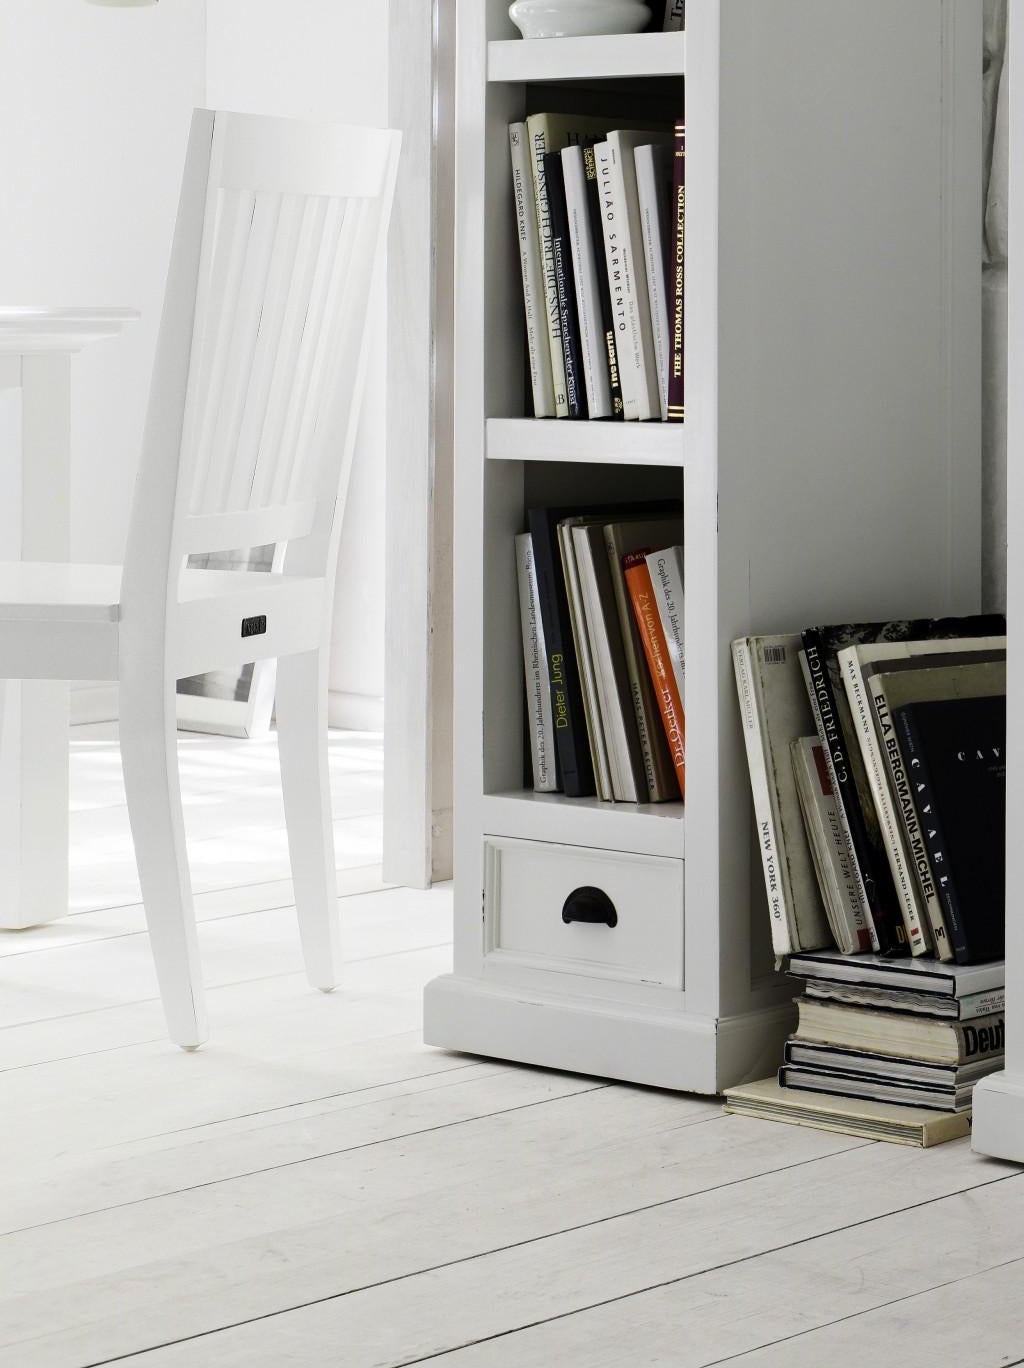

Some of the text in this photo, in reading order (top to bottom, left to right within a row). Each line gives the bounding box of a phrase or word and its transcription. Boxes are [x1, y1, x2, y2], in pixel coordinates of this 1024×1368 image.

[515, 169, 525, 217] HILDEGARD
[535, 131, 550, 213] GENSCHER
[519, 220, 527, 241] KNEF
[542, 216, 562, 339] HANS-DIETRICH
[554, 237, 569, 309] Internationale
[608, 233, 626, 331] SARMENTO
[674, 185, 685, 378] THE THOMAS ROSS COLLECTION
[561, 310, 572, 352] Sprachen
[657, 558, 670, 588] Graphik
[664, 589, 673, 600] des
[527, 571, 538, 625] Landesmuseum
[638, 591, 652, 613] A-Z
[666, 602, 676, 613] 20.
[530, 625, 540, 669] Rheinischen
[645, 614, 658, 635] von
[536, 678, 545, 728] Jahrhunderts
[552, 653, 569, 729] Dieter Jung
[632, 682, 642, 713] HANS
[807, 646, 849, 783] C. D. FRIEDRICH
[847, 660, 870, 734] MAX BECKMANN
[636, 714, 649, 746] PETER
[538, 753, 549, 783] Graphik
[874, 693, 935, 904] ELLA BERGMANN-MICHEL
[911, 757, 948, 887] CAVAEL
[761, 821, 773, 851] NEW
[766, 855, 778, 892] YORK
[827, 810, 863, 926] UNSERE WELT HEUTE
[848, 852, 866, 904] HILDEGARD
[893, 847, 907, 890] FERNAND
